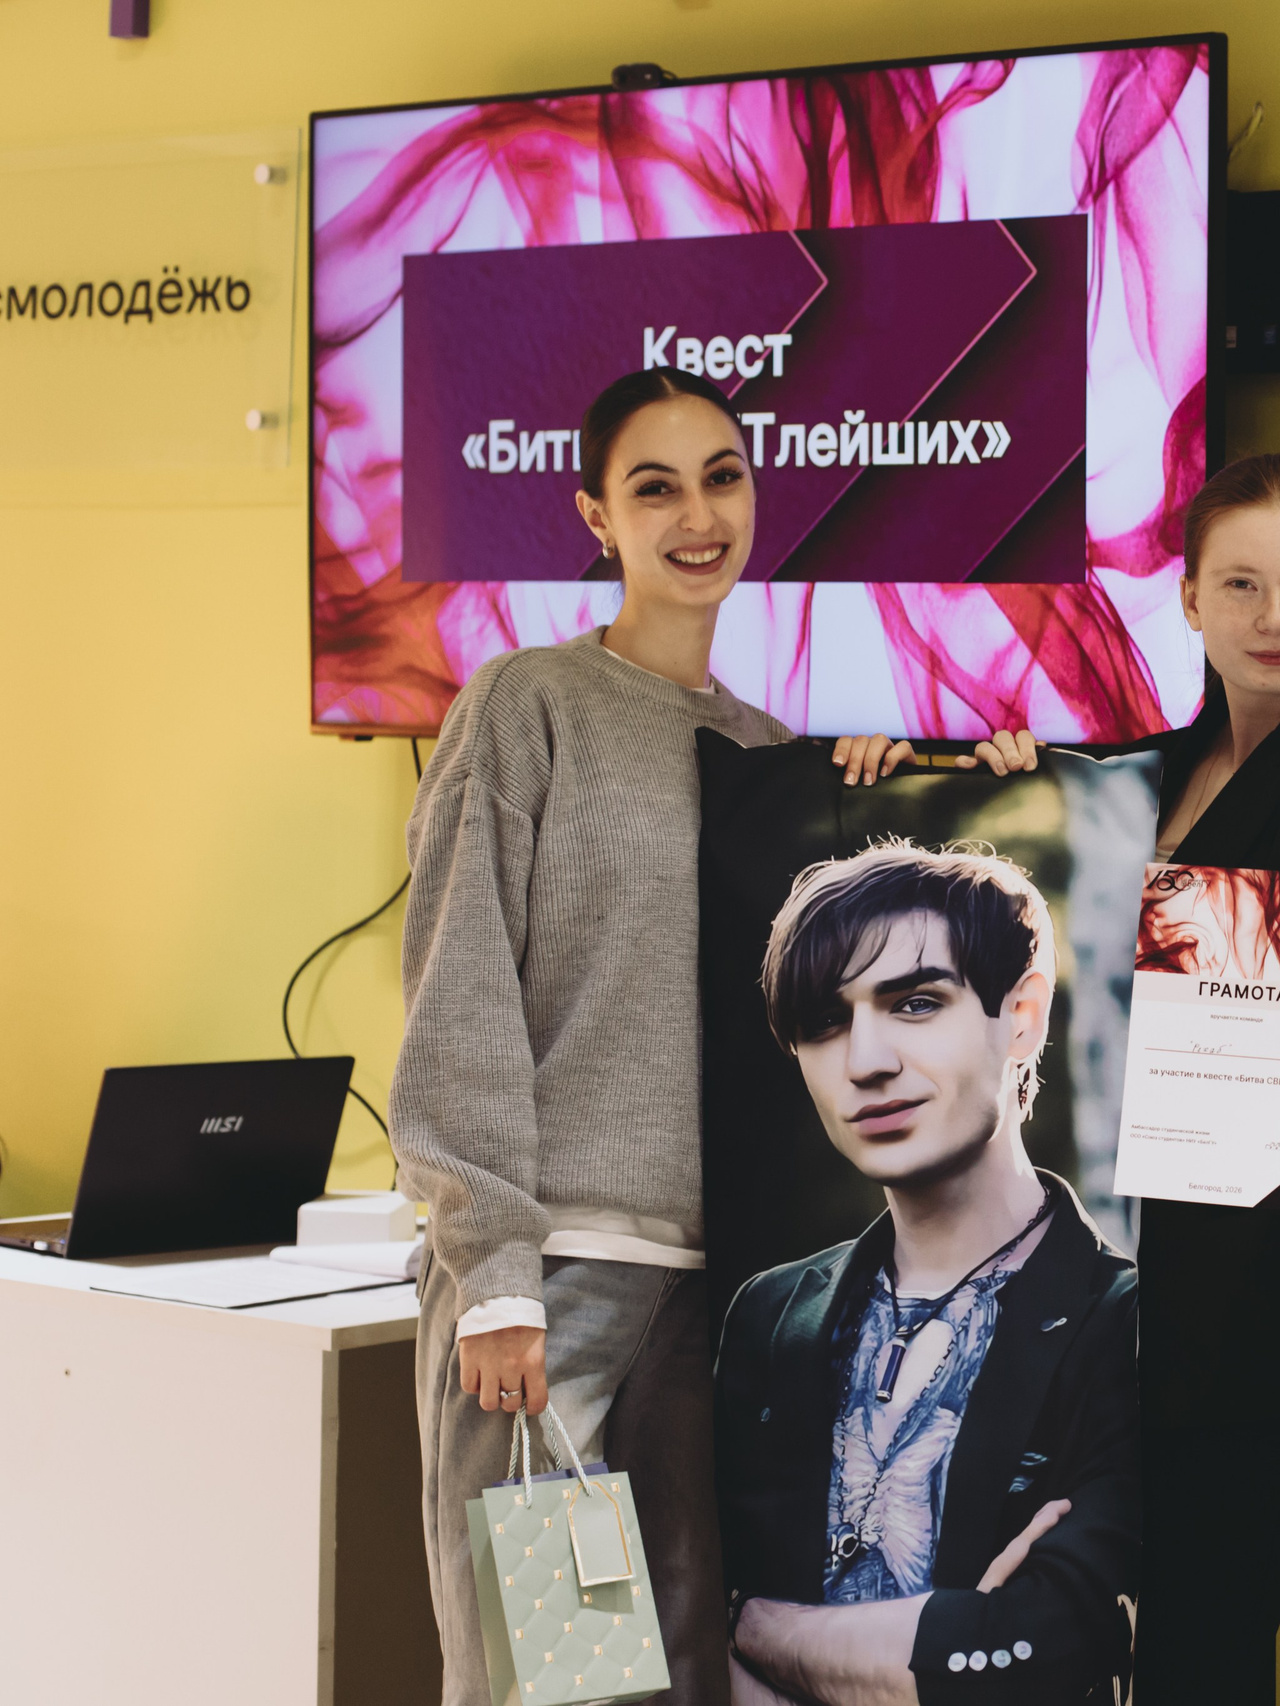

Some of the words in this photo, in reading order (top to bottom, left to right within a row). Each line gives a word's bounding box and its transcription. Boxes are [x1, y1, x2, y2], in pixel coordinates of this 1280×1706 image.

[0, 266, 251, 324] молодёжь
[643, 326, 792, 379] Квест
[1149, 1068, 1159, 1076] за
[1160, 1069, 1195, 1079] участие
[1203, 1073, 1233, 1082] квесте
[1235, 1074, 1265, 1085] «Битва
[1188, 1182, 1223, 1193] Белгород,
